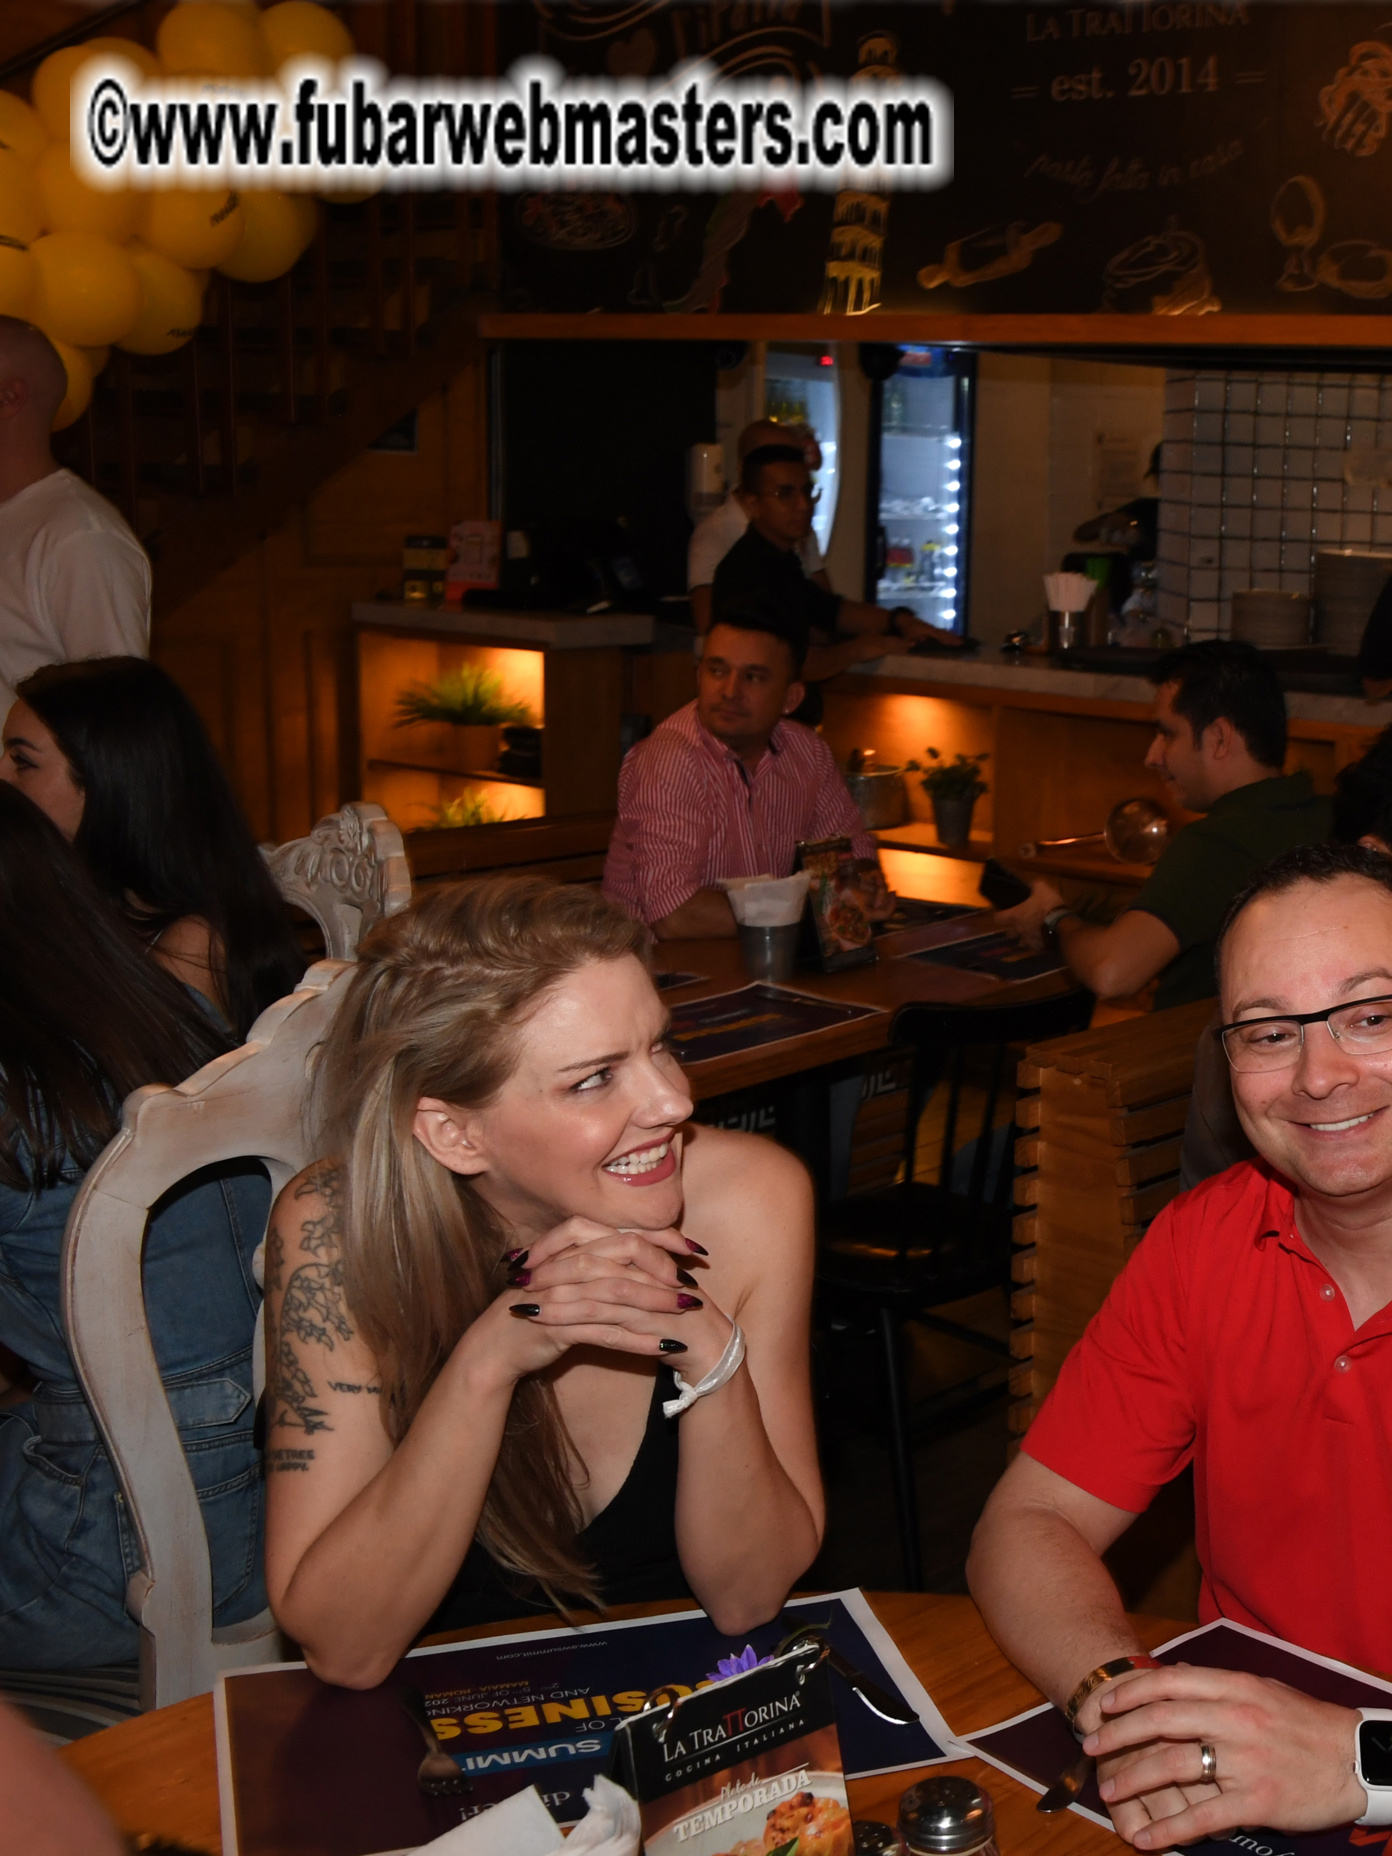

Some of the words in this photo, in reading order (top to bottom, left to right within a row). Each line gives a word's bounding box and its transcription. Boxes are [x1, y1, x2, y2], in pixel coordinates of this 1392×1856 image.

[1050, 66, 1115, 101] est.
[1127, 54, 1220, 97] 2014
[424, 1688, 472, 1700] ROMAN
[424, 1698, 450, 1708] 202
[550, 1686, 591, 1700] AND
[575, 1720, 606, 1735] OF
[662, 1740, 687, 1763] LA
[688, 1693, 802, 1750] TRATTORINA
[460, 1739, 602, 1772] SUMMI
[664, 1753, 721, 1783] COCINA
[736, 1718, 805, 1752] ITALIANA
[673, 1768, 813, 1843] TEMPORADA
[1227, 1834, 1296, 1856] our
